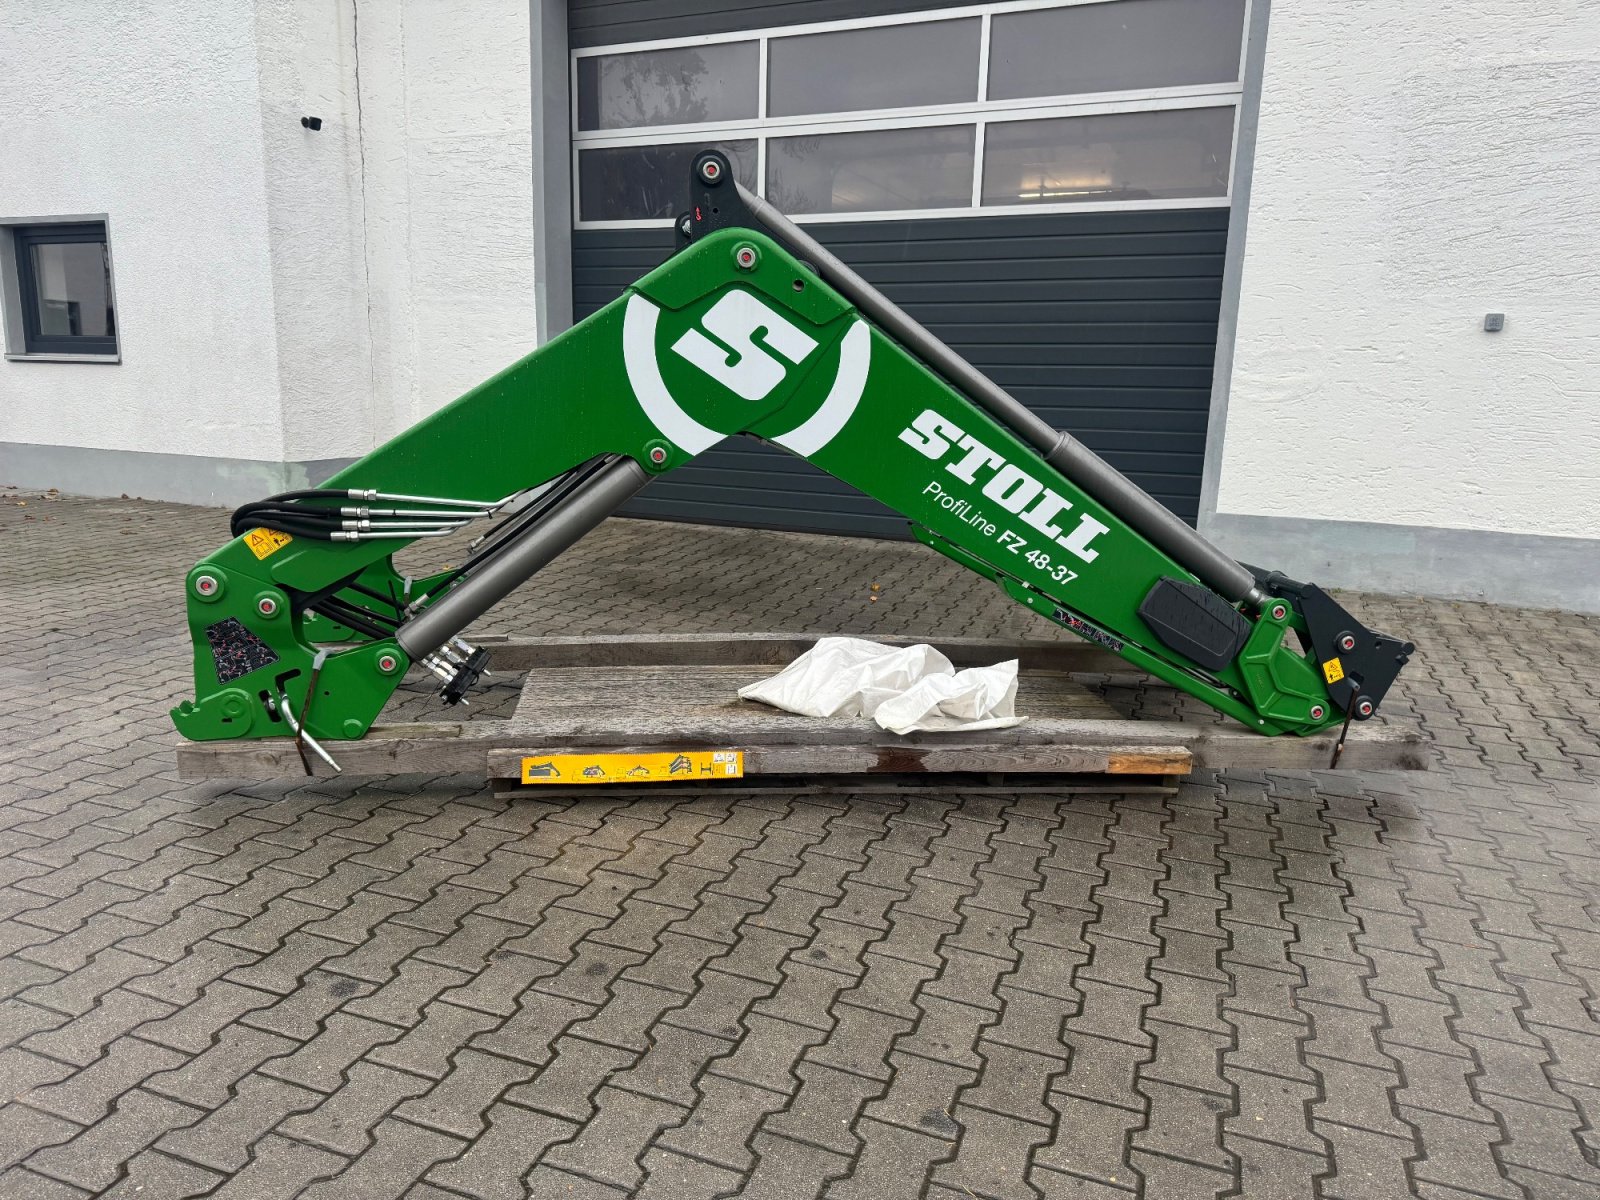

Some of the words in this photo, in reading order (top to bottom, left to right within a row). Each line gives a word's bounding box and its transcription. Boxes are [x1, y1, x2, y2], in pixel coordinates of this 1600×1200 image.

[670, 289, 820, 400] S
[897, 409, 1111, 564] STOLL
[922, 481, 996, 536] ProfiLine
[996, 529, 1028, 554] FZ
[1024, 549, 1079, 585] 48-37
